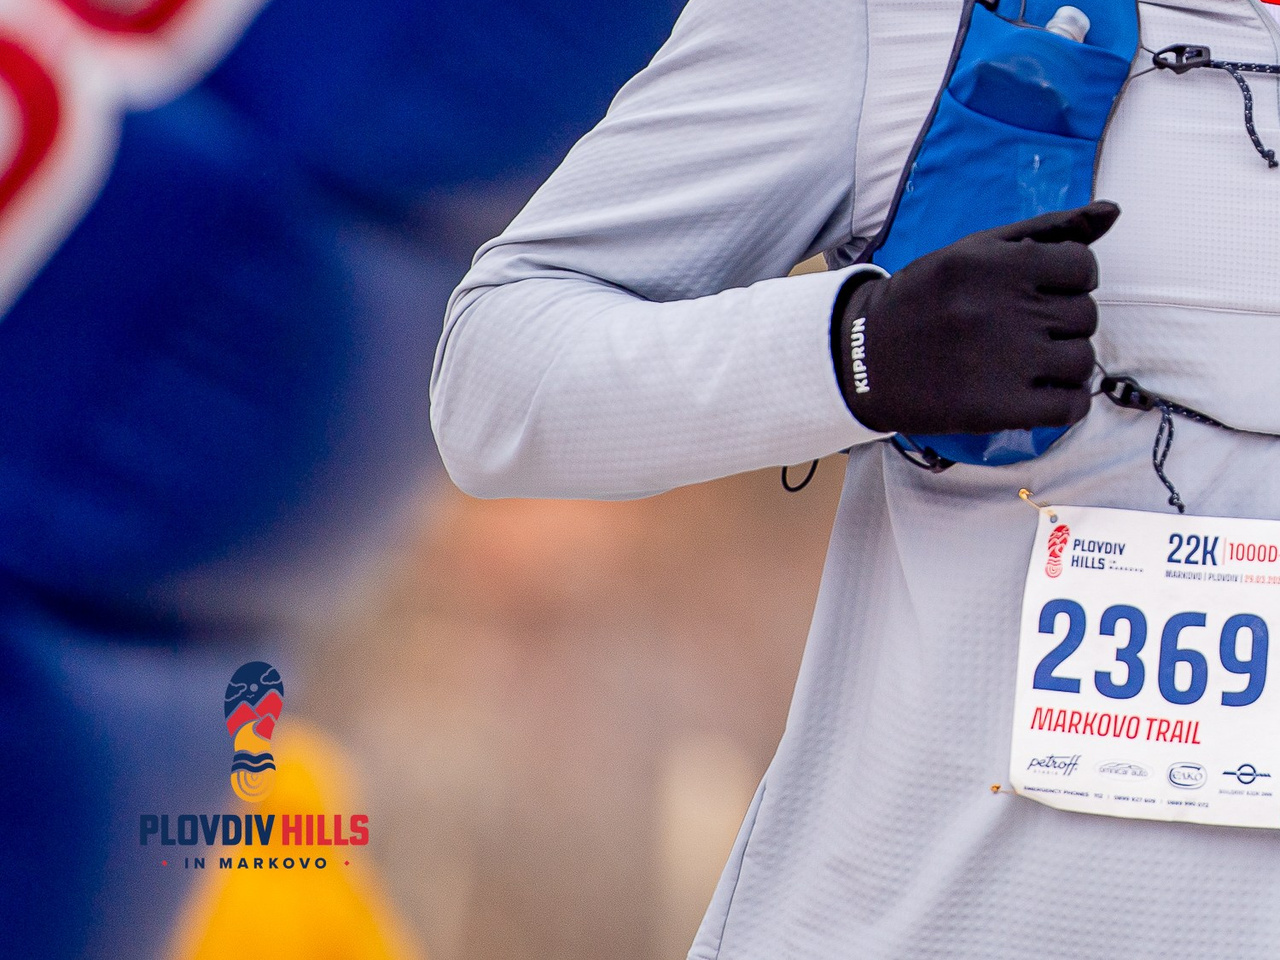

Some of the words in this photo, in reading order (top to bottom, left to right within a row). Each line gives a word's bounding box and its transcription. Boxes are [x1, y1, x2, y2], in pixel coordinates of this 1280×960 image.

[851, 317, 870, 394] KIPRUN
[1071, 554, 1105, 570] HILLS
[1073, 538, 1126, 556] PLOVDIV
[1166, 533, 1220, 566] 22K
[1033, 598, 1269, 707] 2369
[1030, 707, 1140, 740] MARKOVO
[1146, 717, 1202, 745] TRAIL
